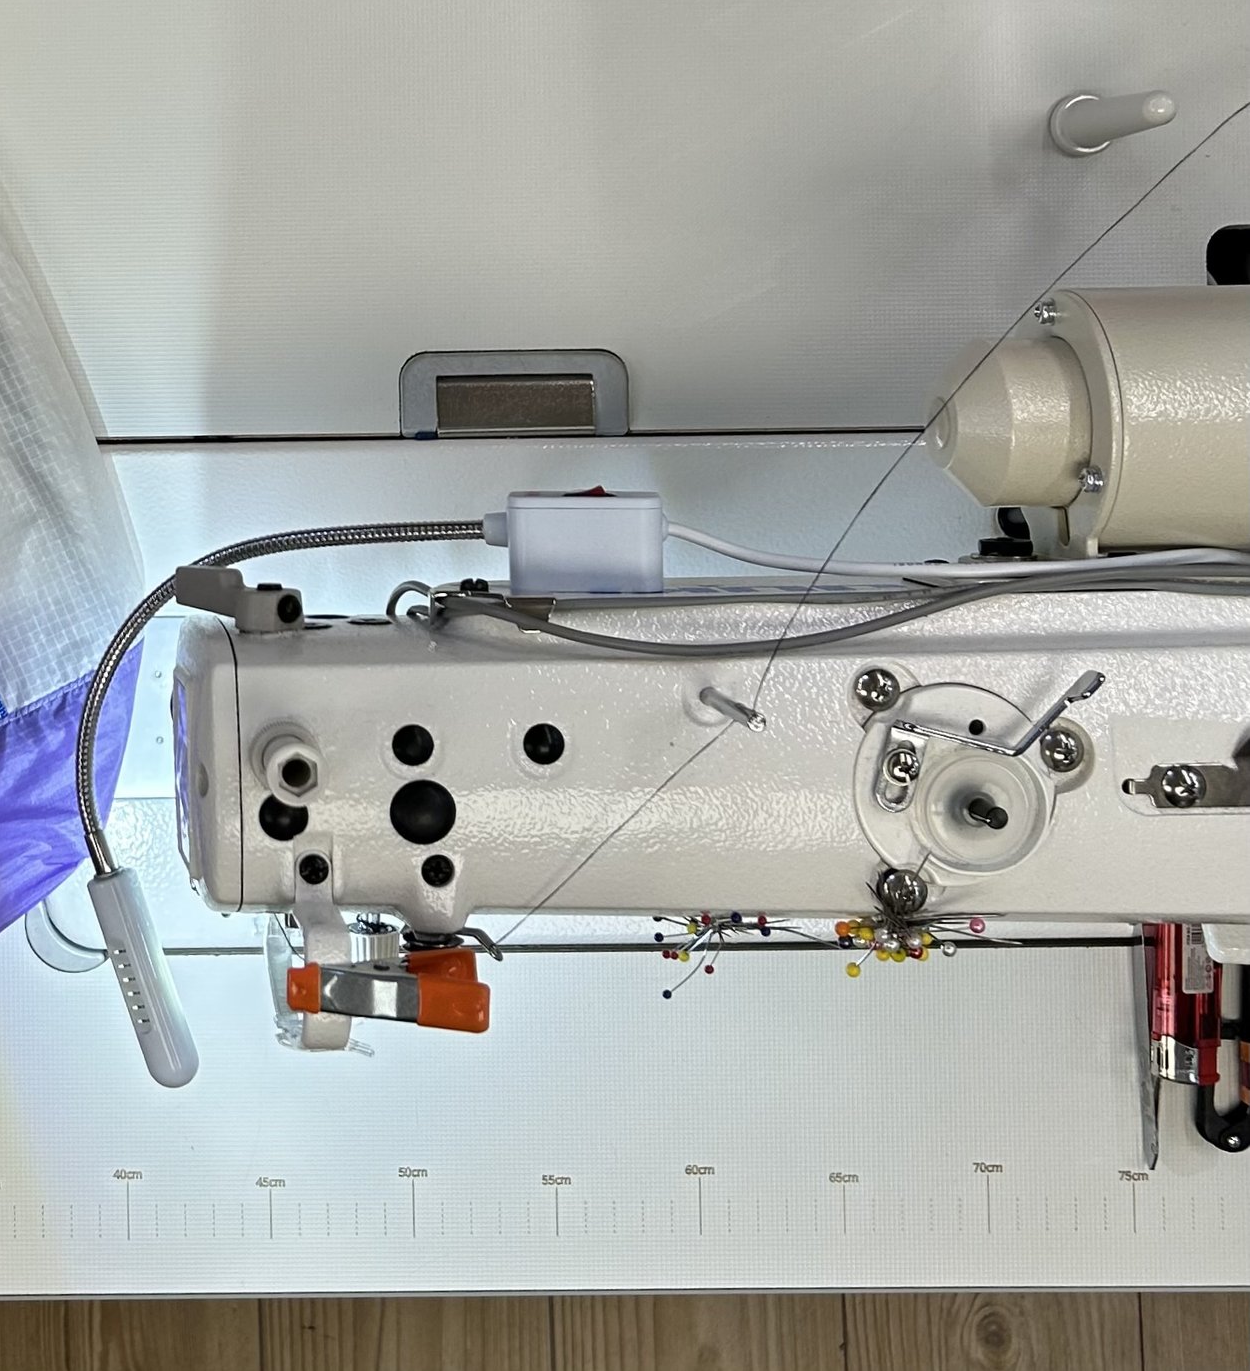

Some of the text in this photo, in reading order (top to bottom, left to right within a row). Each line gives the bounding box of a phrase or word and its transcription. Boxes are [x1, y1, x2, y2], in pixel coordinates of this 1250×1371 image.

[398, 1167, 428, 1178] 50cm
[685, 1165, 715, 1176] 60cm
[973, 1162, 1003, 1173] 70cm
[112, 1169, 143, 1180] 40cm
[829, 1172, 859, 1183] 65cm
[1118, 1170, 1149, 1181] 75cm
[255, 1177, 286, 1188] 45cm
[541, 1175, 571, 1186] 55cm
